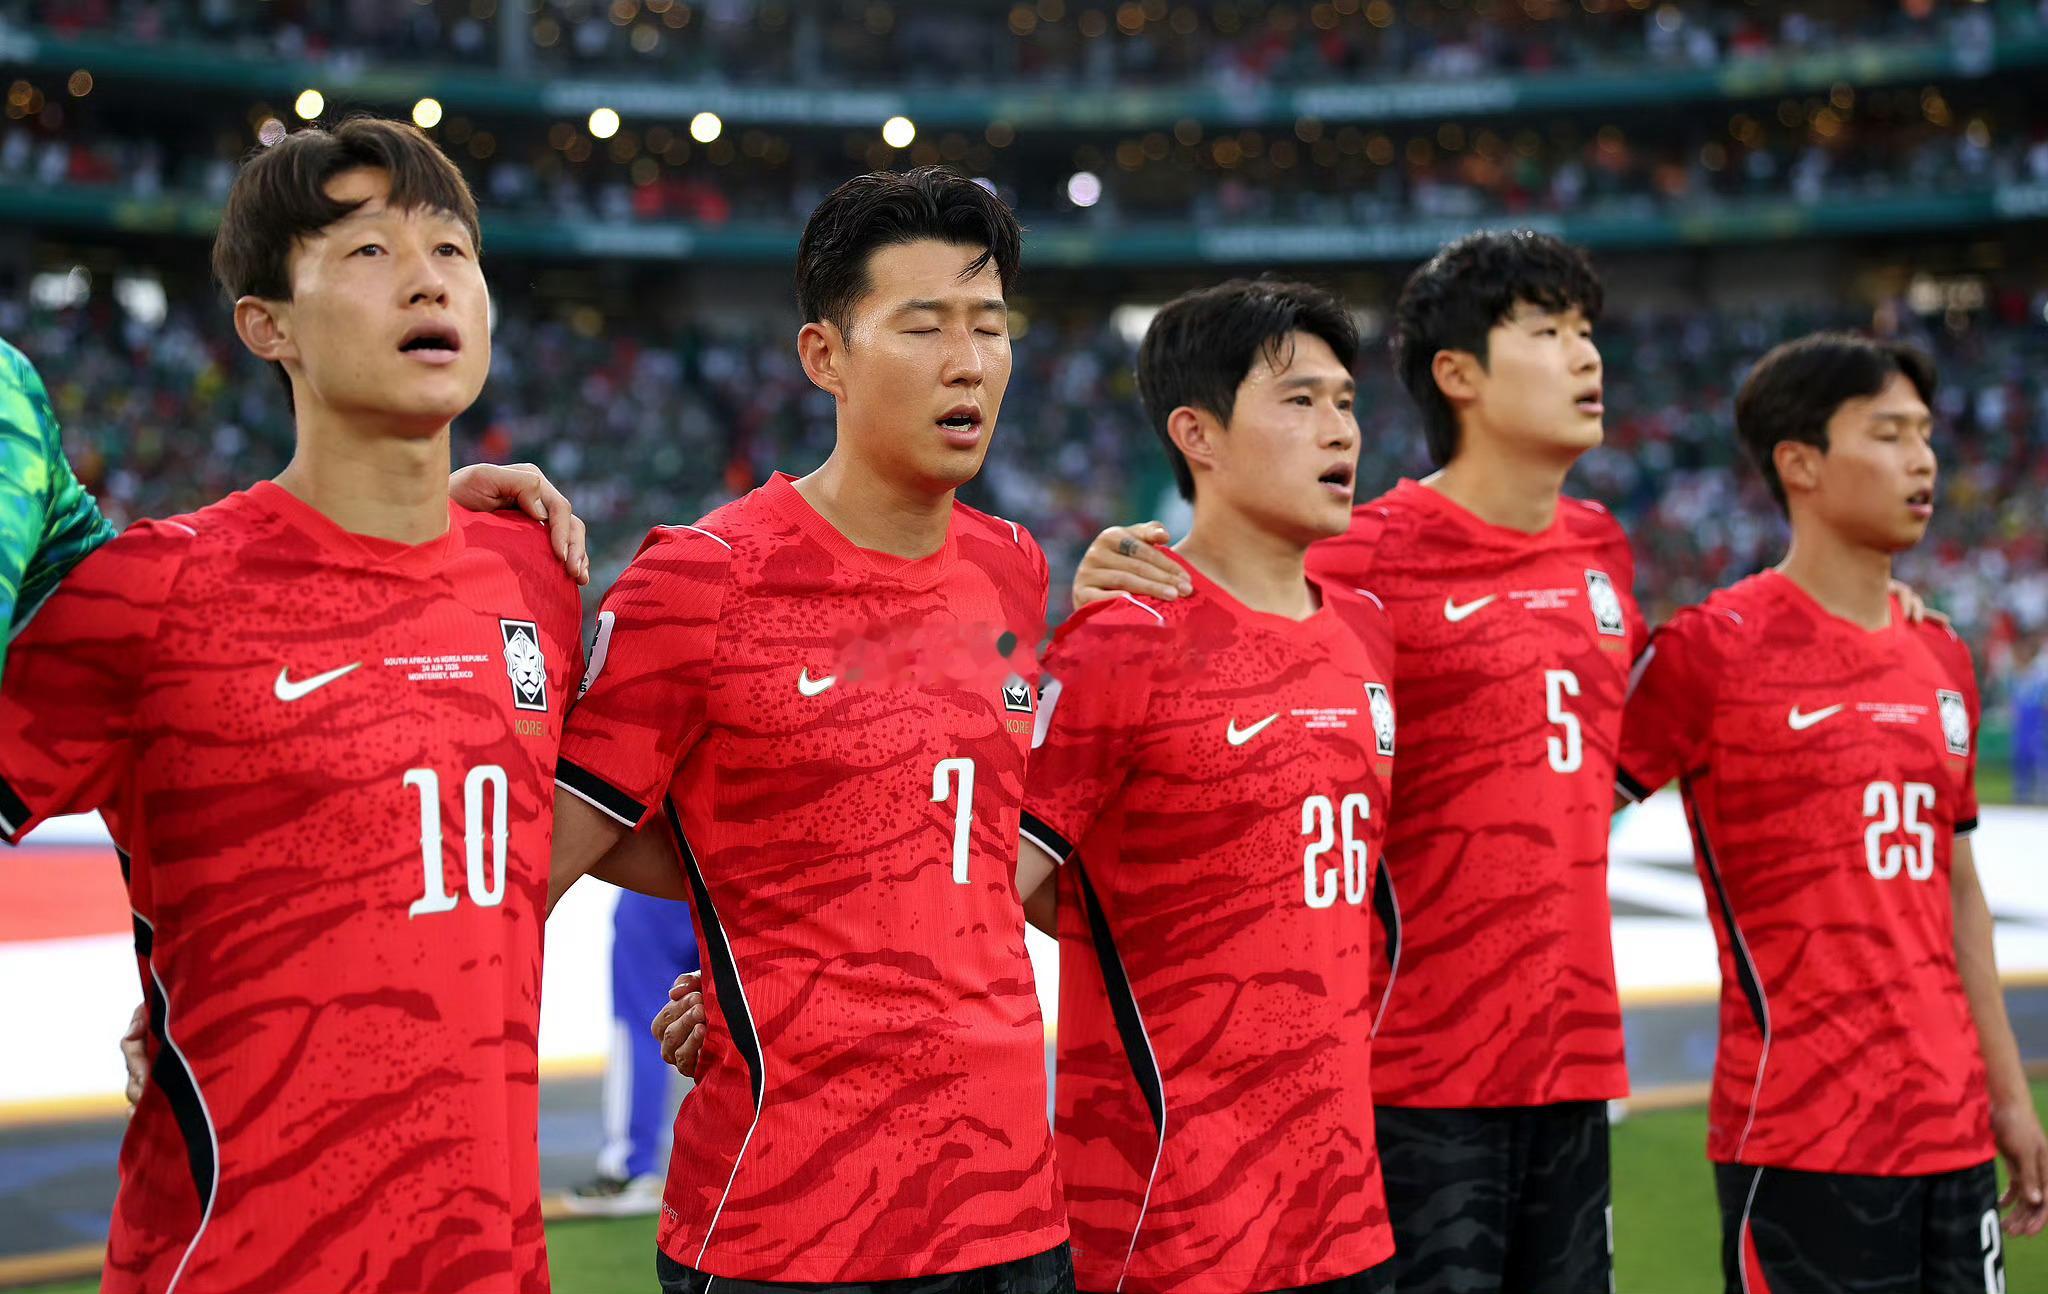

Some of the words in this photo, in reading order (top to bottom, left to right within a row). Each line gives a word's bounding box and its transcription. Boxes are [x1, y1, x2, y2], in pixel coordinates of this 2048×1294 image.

[384, 657, 408, 666] SOUTH
[409, 656, 432, 664] AFRICA
[440, 655, 461, 663] KOREA
[462, 654, 489, 662] REPUBLIC
[408, 672, 449, 681] MONTERREY,
[450, 671, 473, 679] MEXICO
[514, 719, 546, 736] KORE
[1006, 719, 1032, 735] KORE
[1545, 669, 1582, 773] 5
[403, 765, 508, 920] 10
[930, 757, 975, 884] 7
[1301, 793, 1370, 909] 26
[1862, 781, 1935, 881] 25
